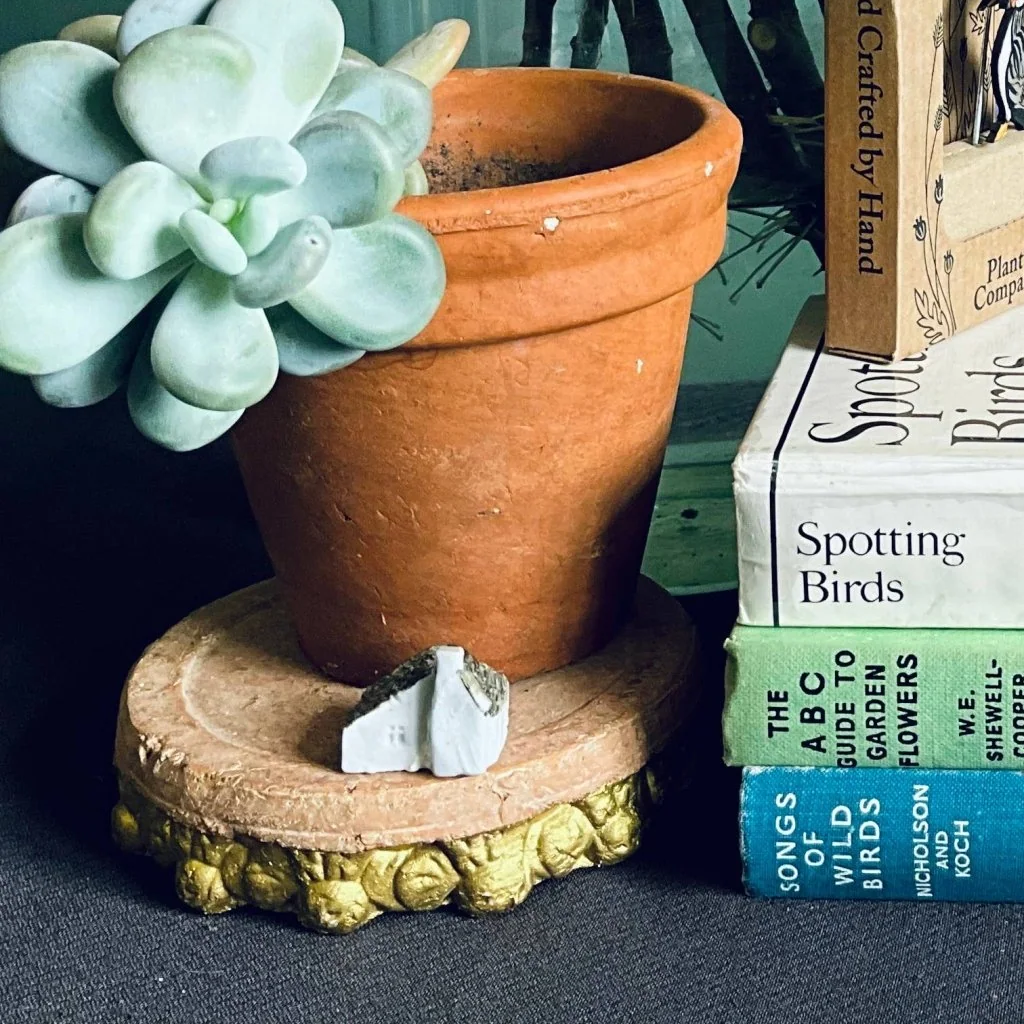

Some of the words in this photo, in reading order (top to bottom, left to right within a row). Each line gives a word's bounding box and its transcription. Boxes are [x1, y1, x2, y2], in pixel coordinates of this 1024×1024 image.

[857, 26, 884, 140] Crafted
[850, 147, 884, 185] by
[858, 189, 883, 275] Hand
[987, 254, 1024, 283] Plant
[796, 521, 966, 566] Spotting
[800, 570, 904, 604] Birds
[834, 650, 856, 687] TO
[767, 690, 789, 738] THE
[834, 702, 857, 768] GUIDE
[864, 664, 887, 761] GARDEN
[896, 653, 919, 767] FLOWERS
[958, 689, 976, 737] W.E.
[985, 659, 1004, 762] SHEWELL-
[775, 792, 800, 892] SONGS
[803, 831, 825, 867] OF
[831, 804, 855, 886] WILD
[859, 797, 883, 890] BIRDS
[912, 784, 933, 897] NICHOLSON
[934, 830, 949, 870] AND
[954, 820, 971, 878] KOCH
